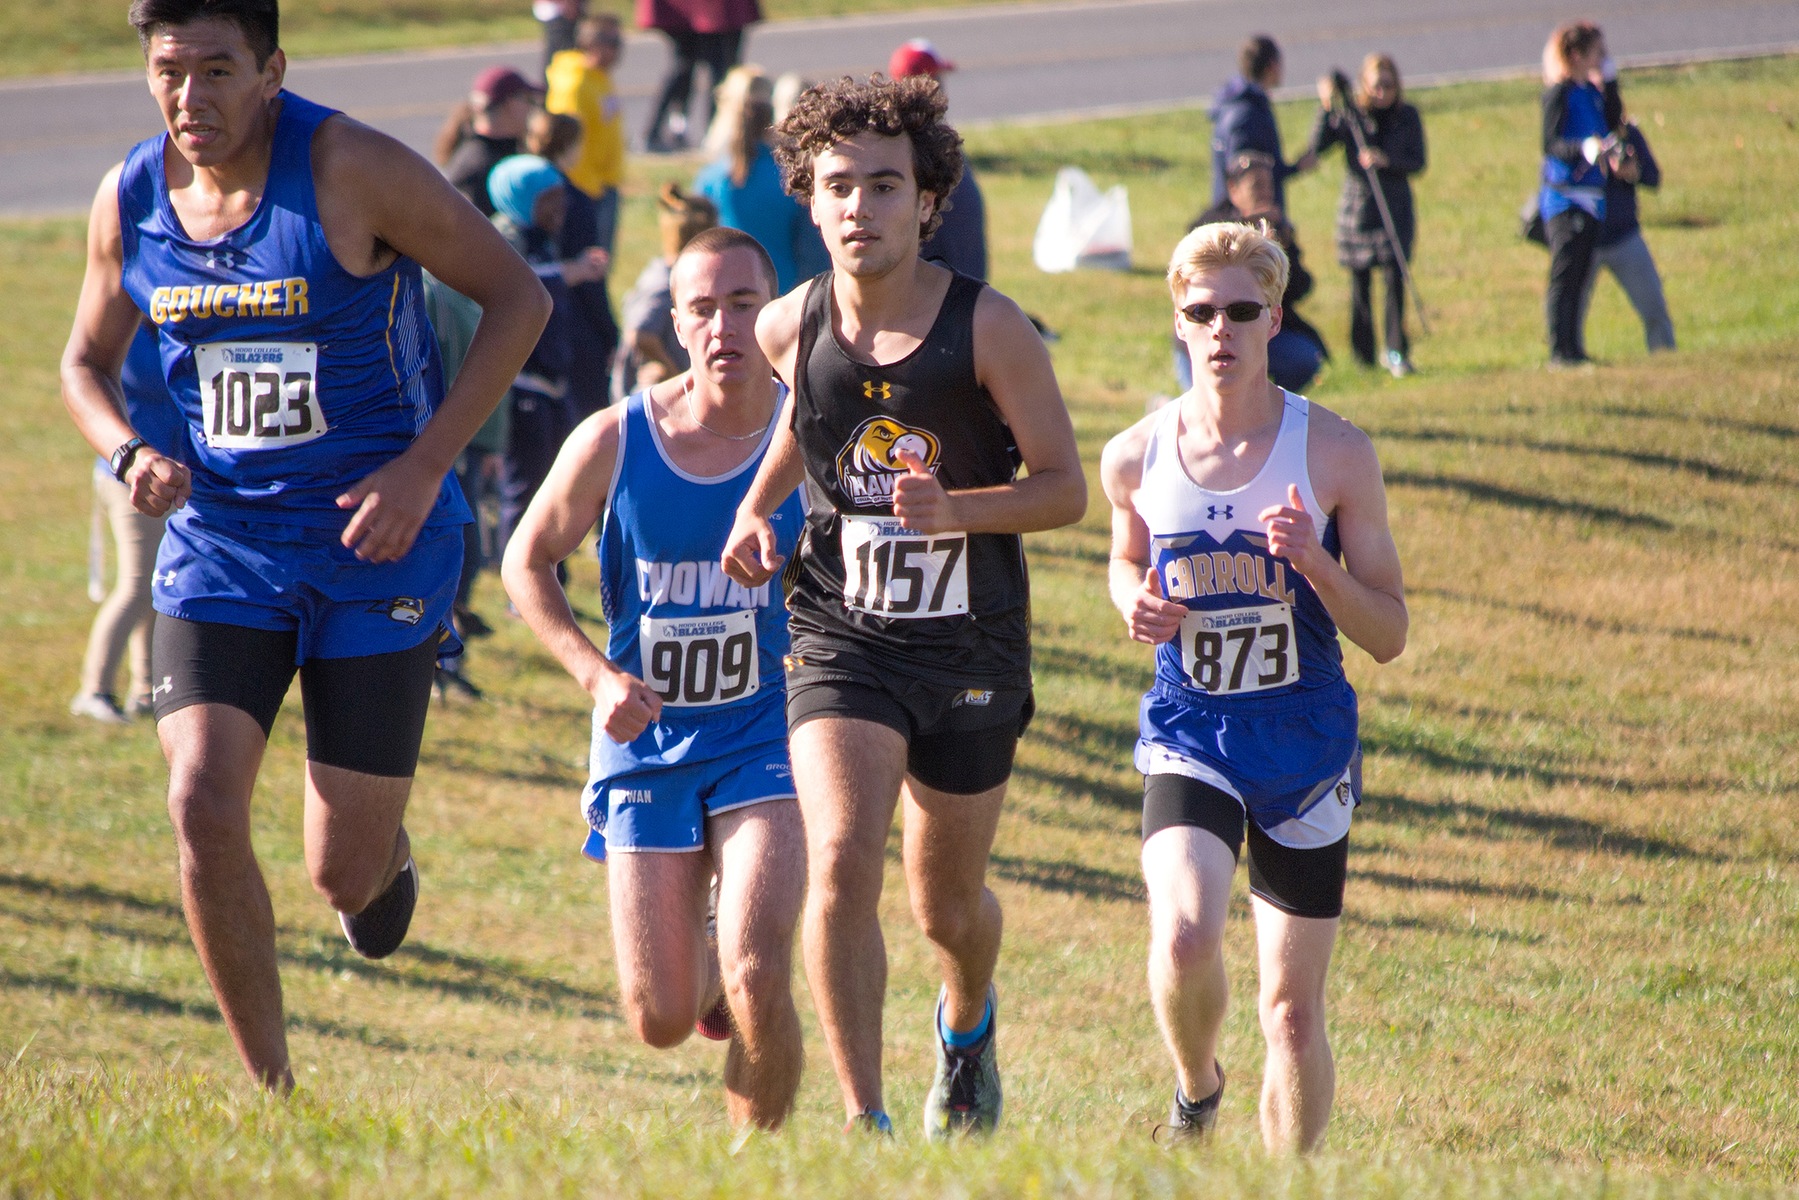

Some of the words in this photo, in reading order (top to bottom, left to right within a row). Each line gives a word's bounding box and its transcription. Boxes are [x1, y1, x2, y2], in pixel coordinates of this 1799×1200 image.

[150, 276, 309, 324] GOUCHER
[235, 353, 283, 363] BLAZERS
[211, 371, 312, 437] 1023
[849, 472, 904, 496] HAW
[854, 537, 965, 614] 1157
[1165, 551, 1295, 607] CARROLL
[678, 624, 727, 636] BLAZERS
[1215, 615, 1262, 628] BLAZERS
[651, 632, 752, 703] 909
[1193, 623, 1289, 691] 873
